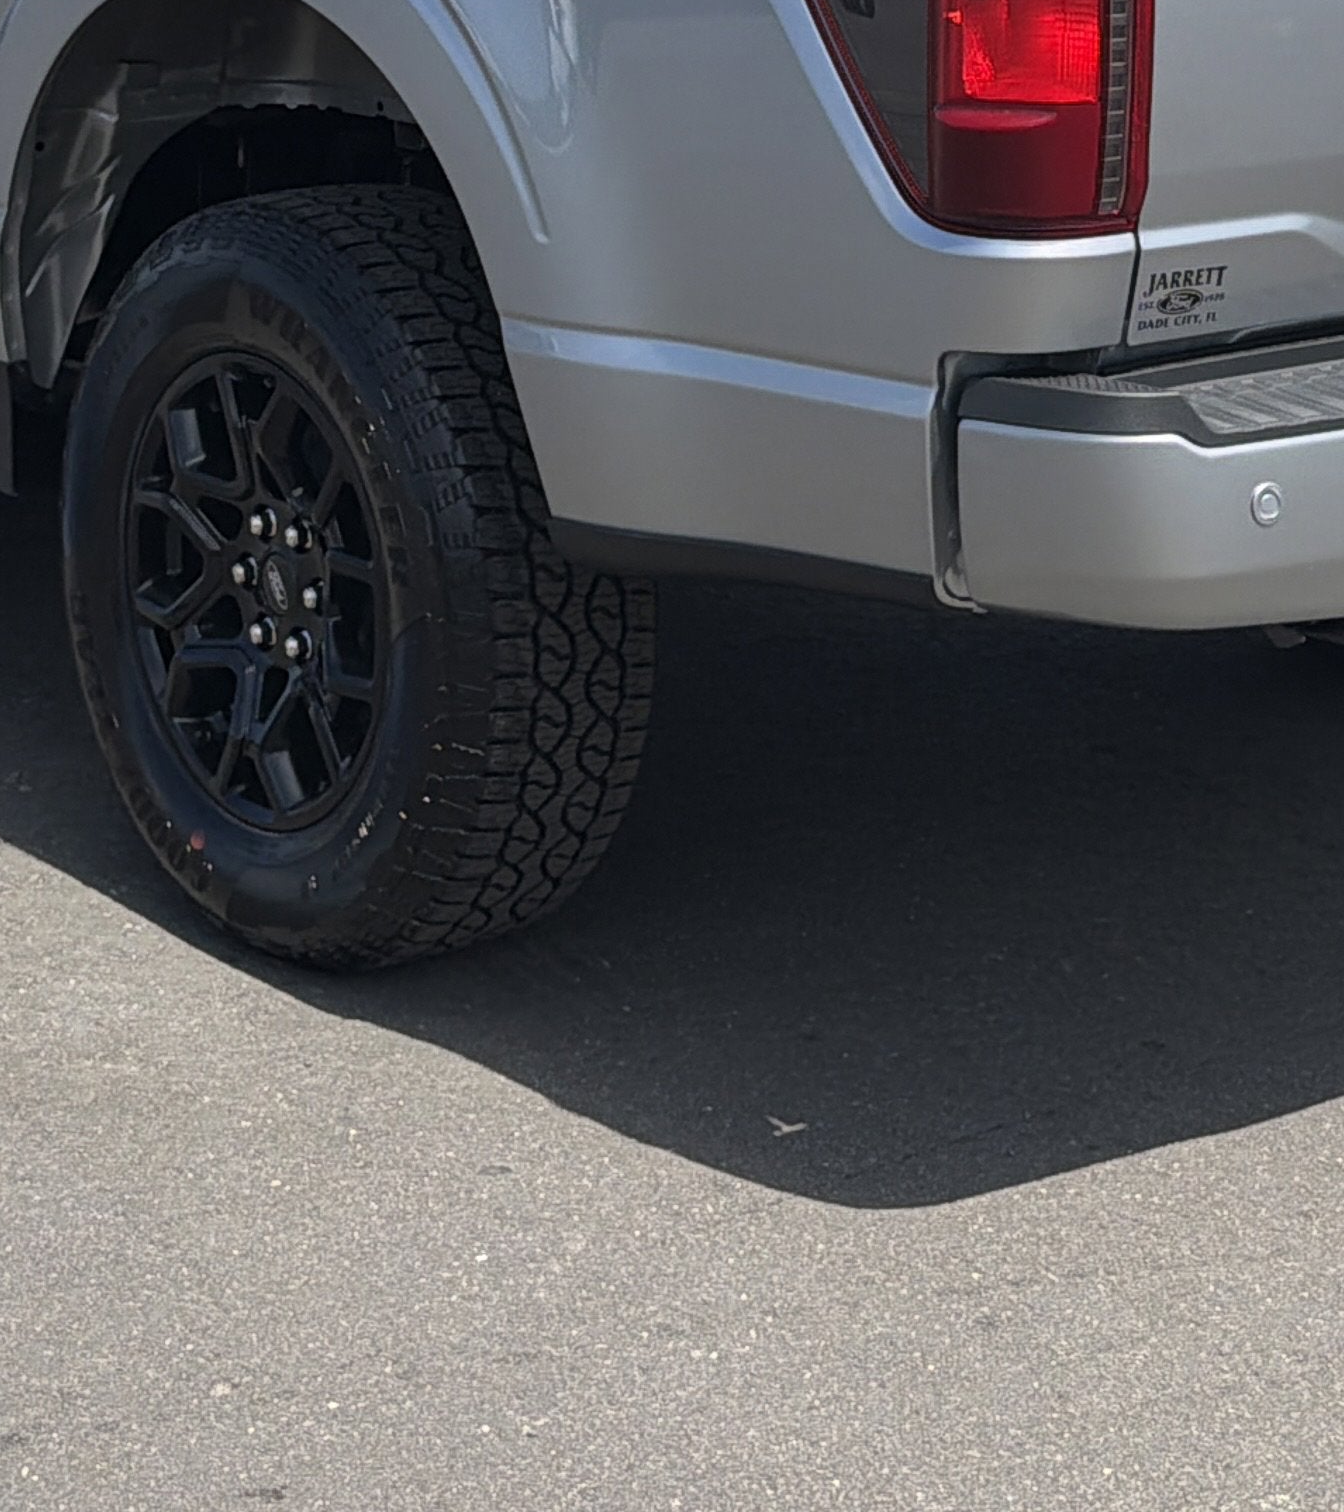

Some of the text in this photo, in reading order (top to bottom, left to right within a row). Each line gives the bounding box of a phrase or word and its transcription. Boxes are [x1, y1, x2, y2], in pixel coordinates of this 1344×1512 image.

[1143, 265, 1229, 297] JARRETT
[1138, 318, 1168, 330] DADE
[1206, 312, 1217, 322] FL
